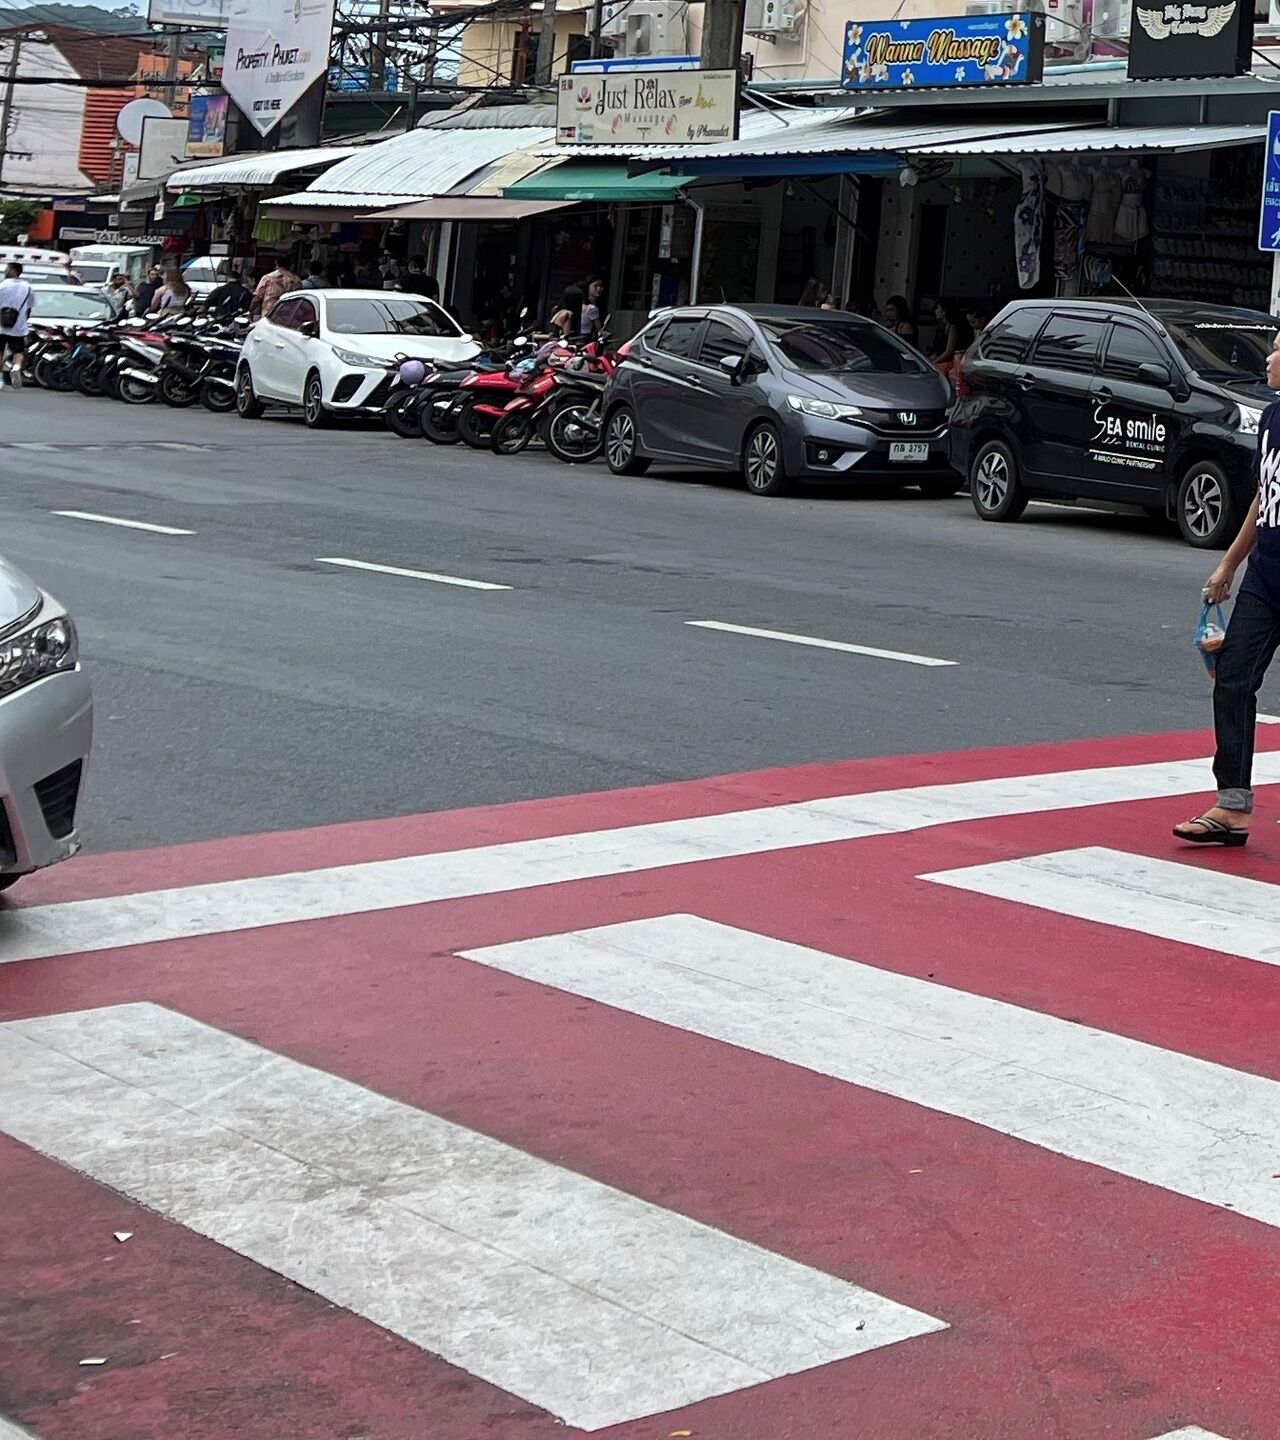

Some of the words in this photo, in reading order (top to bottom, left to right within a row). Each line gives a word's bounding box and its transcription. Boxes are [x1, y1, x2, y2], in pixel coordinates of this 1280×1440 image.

[867, 34, 924, 66] Wanna
[928, 30, 1000, 67] Massage
[595, 79, 630, 116] Just
[634, 78, 676, 110] Relax
[1090, 398, 1123, 442] SEA
[1125, 440, 1146, 450] DENTAL
[1146, 443, 1166, 453] CLINIC
